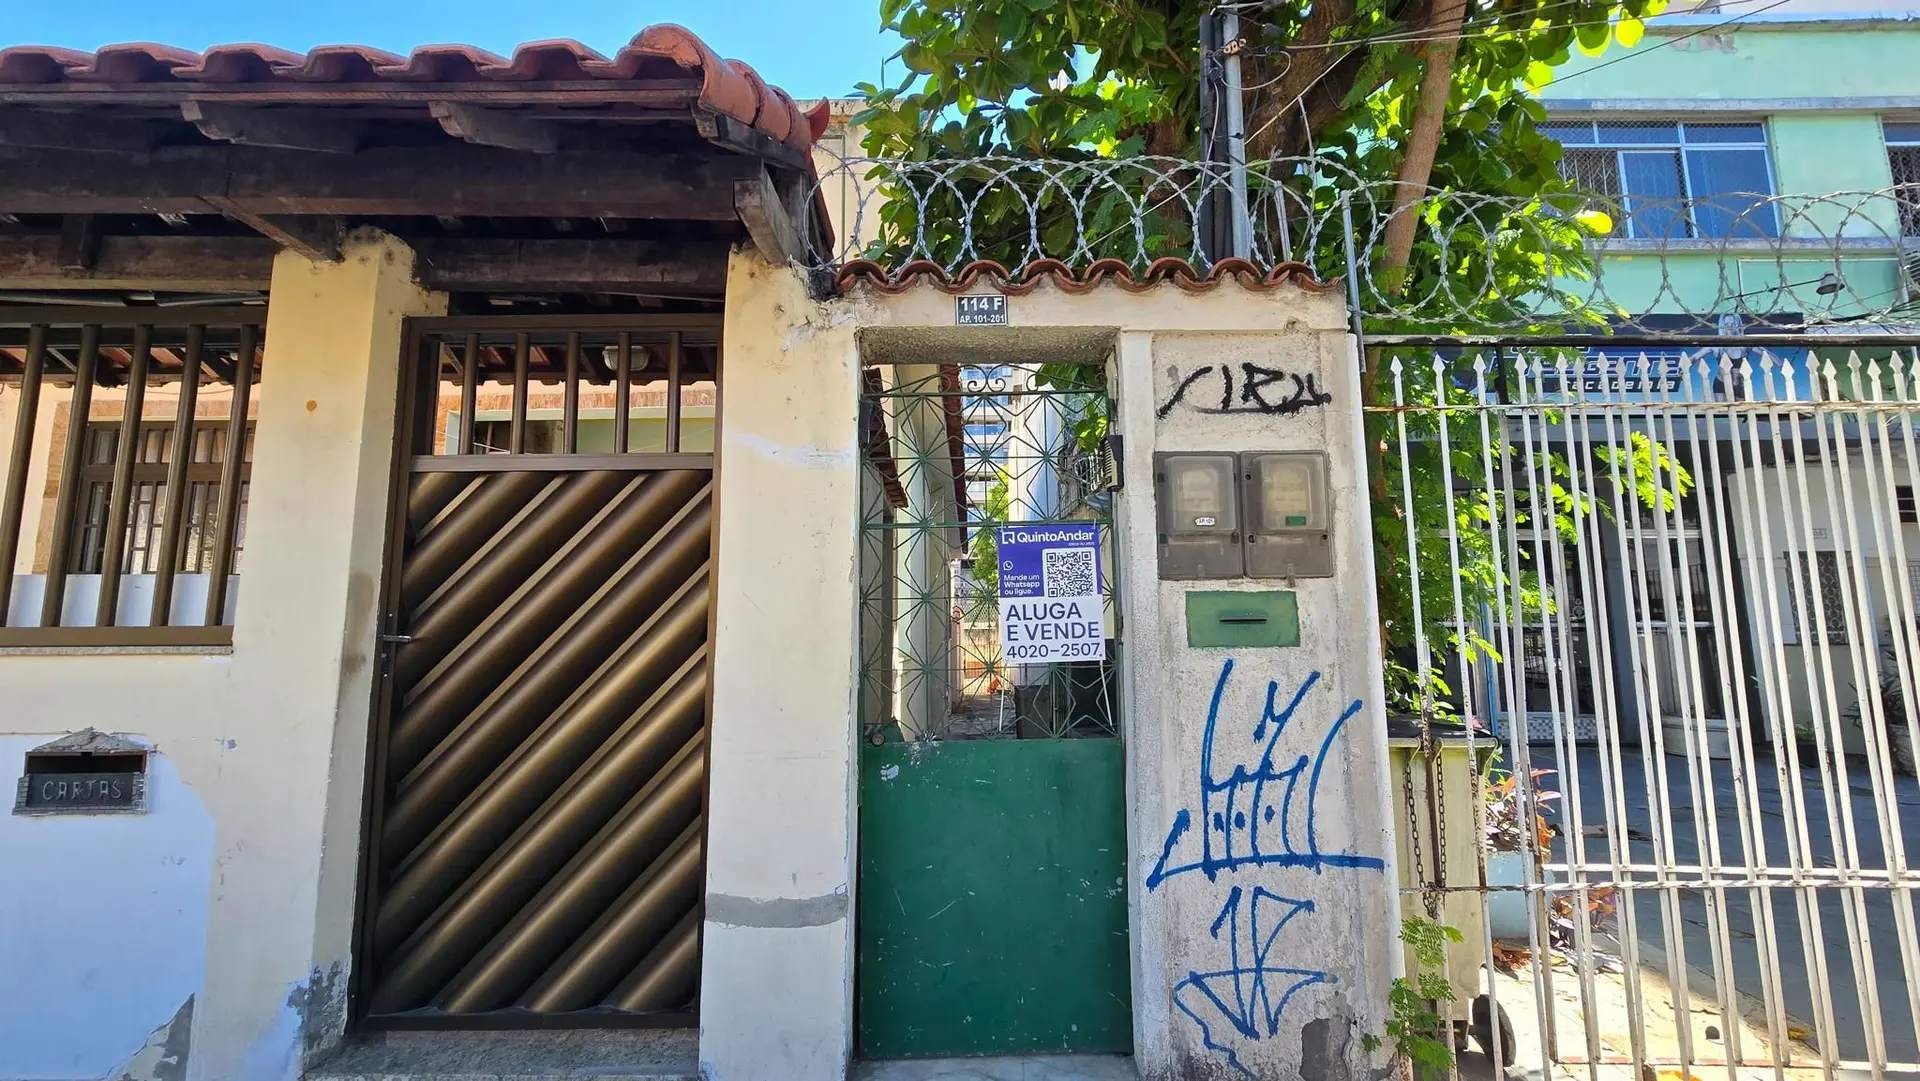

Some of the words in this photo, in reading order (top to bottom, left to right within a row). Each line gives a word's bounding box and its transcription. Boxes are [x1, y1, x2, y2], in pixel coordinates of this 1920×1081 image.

[961, 297, 989, 311] 114
[993, 297, 1003, 311] F
[959, 315, 972, 324] AP.
[973, 314, 1004, 323] 101-201
[1016, 530, 1095, 543] QuintoAndar
[1003, 581, 1041, 589] Whatsapp
[1014, 587, 1034, 596] ligue.
[1005, 602, 1082, 621] ALUGA
[1007, 624, 1019, 642] E
[1024, 621, 1100, 641] VENDE
[42, 779, 122, 800] CARTAS
